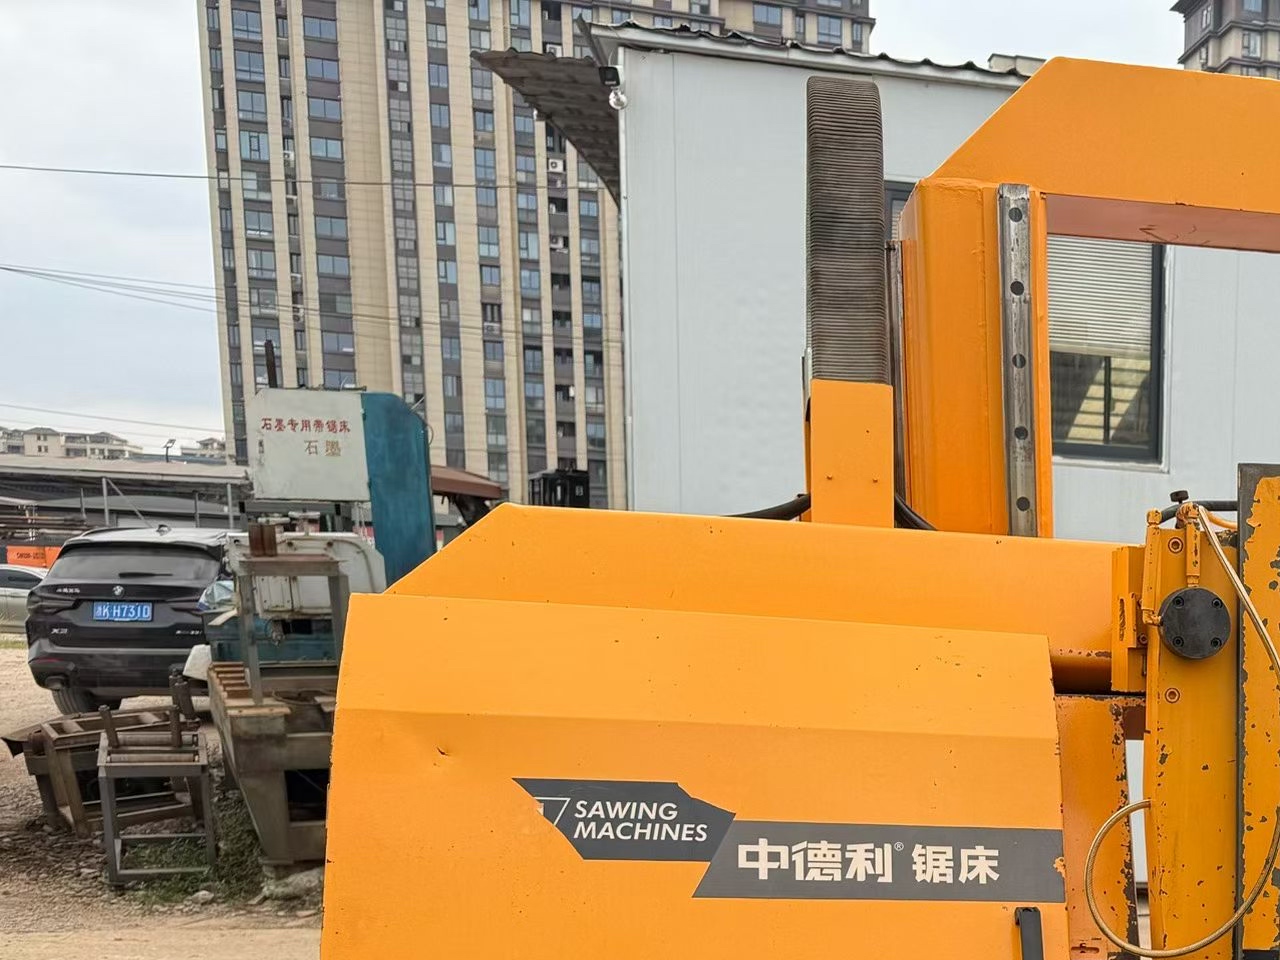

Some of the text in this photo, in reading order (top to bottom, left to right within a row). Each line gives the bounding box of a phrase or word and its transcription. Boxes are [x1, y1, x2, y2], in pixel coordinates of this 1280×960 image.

[303, 439, 342, 457] 石墨
[574, 800, 678, 821] SAWING
[573, 821, 708, 842] MACHINES
[911, 843, 1000, 884] 锯床
